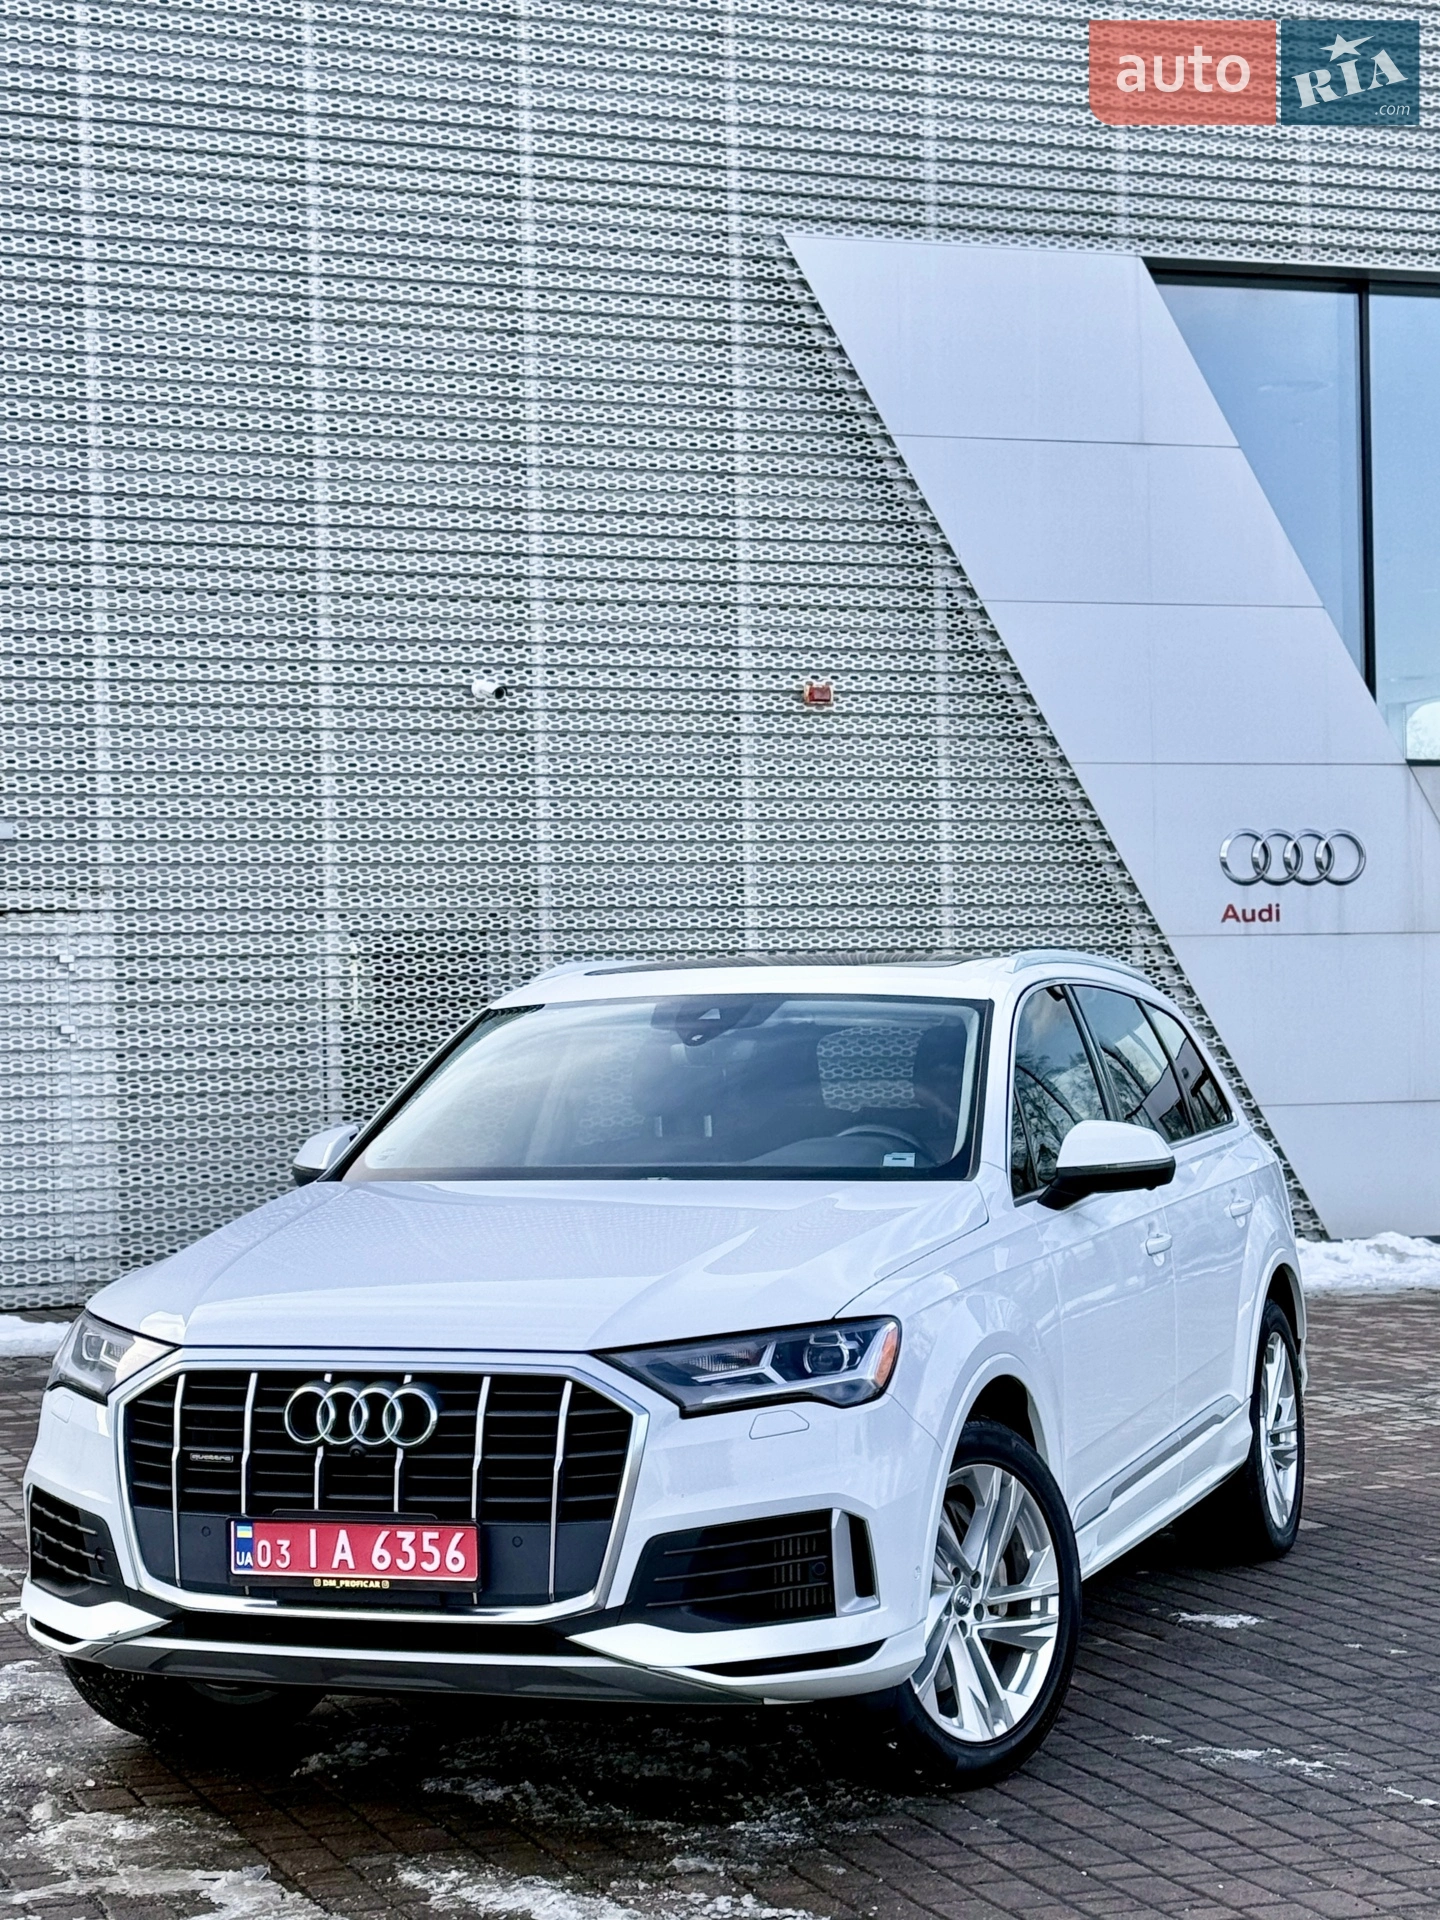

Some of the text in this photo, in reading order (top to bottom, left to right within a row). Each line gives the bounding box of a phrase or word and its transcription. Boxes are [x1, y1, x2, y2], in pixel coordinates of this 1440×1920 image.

[1221, 903, 1281, 923] Audi
[236, 1551, 253, 1567] UA
[257, 1539, 291, 1569] 03
[371, 1531, 466, 1573] 6356
